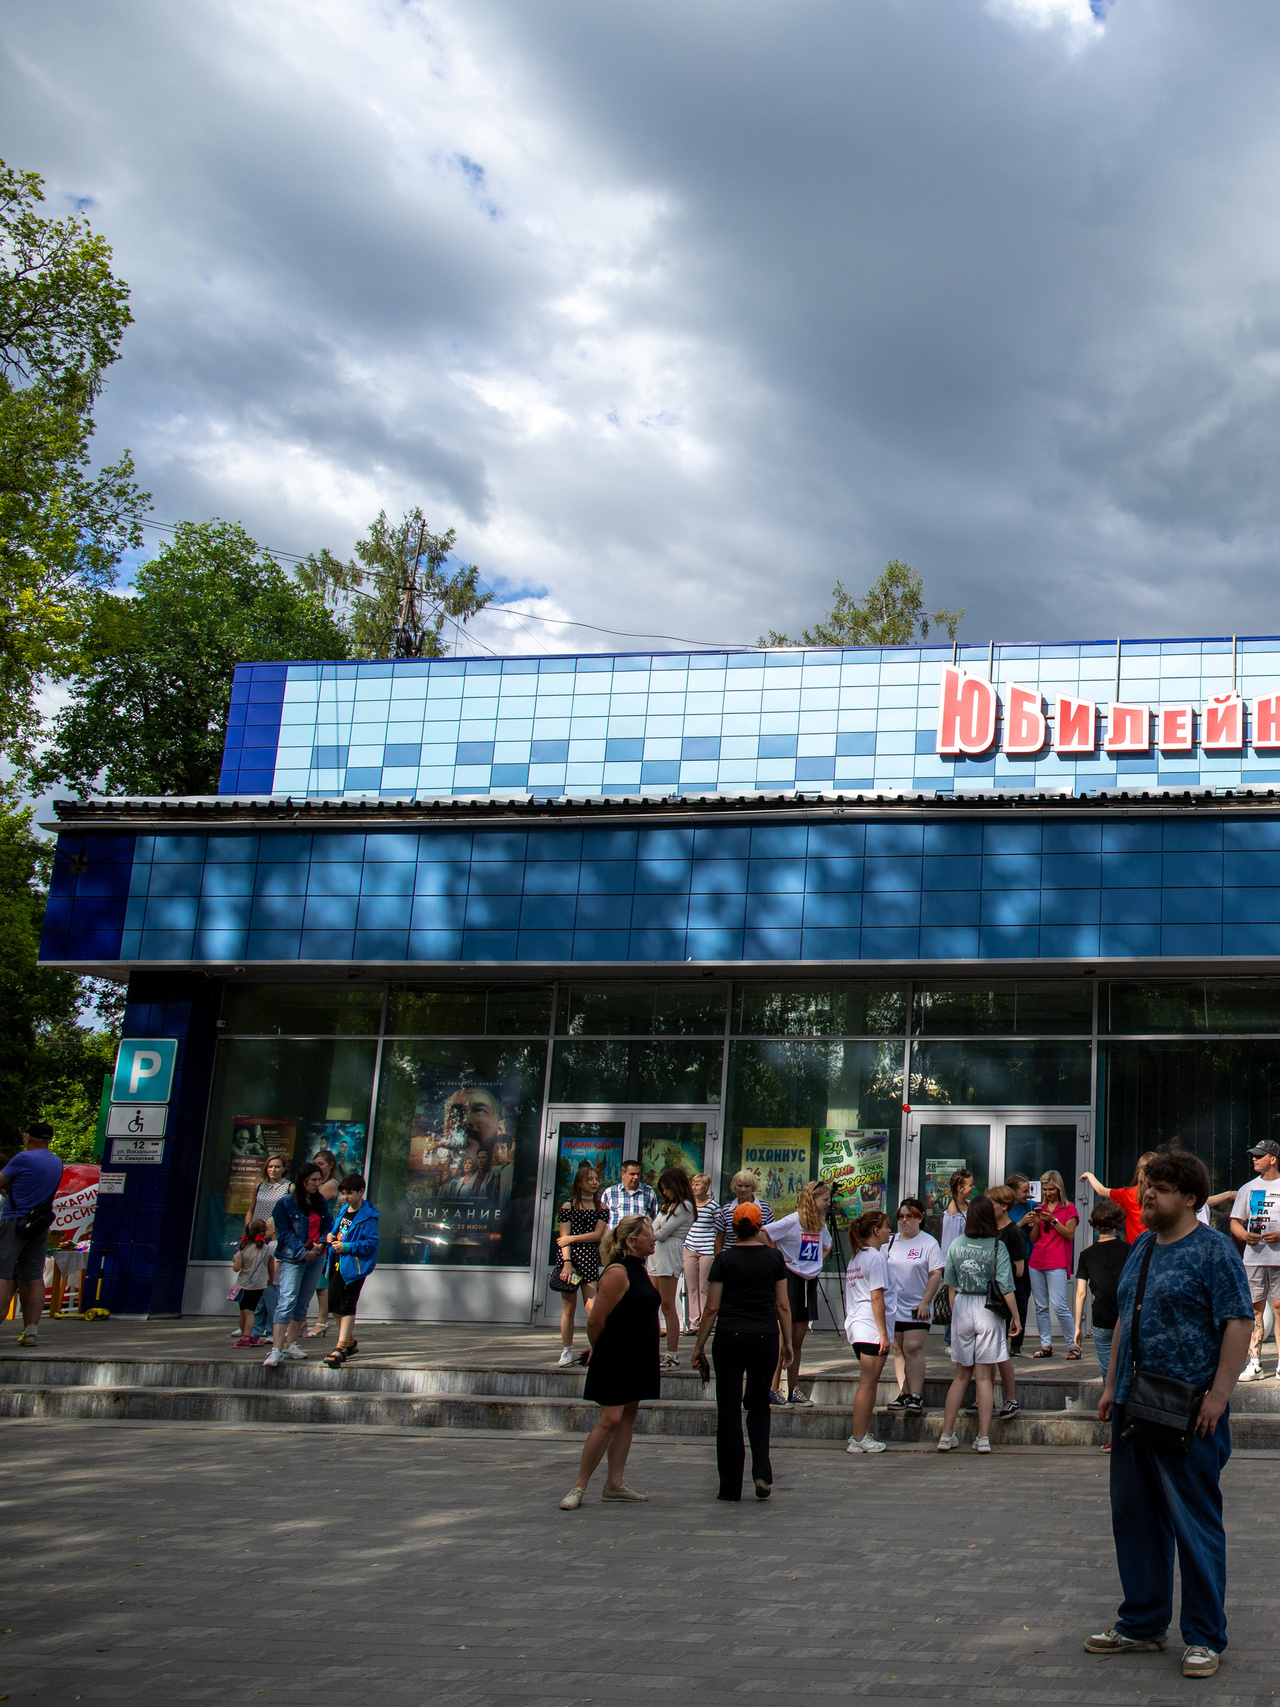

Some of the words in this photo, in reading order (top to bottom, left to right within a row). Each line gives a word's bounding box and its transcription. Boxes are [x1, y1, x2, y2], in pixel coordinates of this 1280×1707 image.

[133, 1141, 145, 1149] 12
[563, 1140, 619, 1150] МАРМАДЮК
[823, 1141, 843, 1155] 24
[745, 1148, 806, 1163] ЮХАННУС
[926, 1162, 937, 1170] 28
[413, 1207, 502, 1221] ДЫХАНИЕ
[801, 1242, 819, 1260] 47
